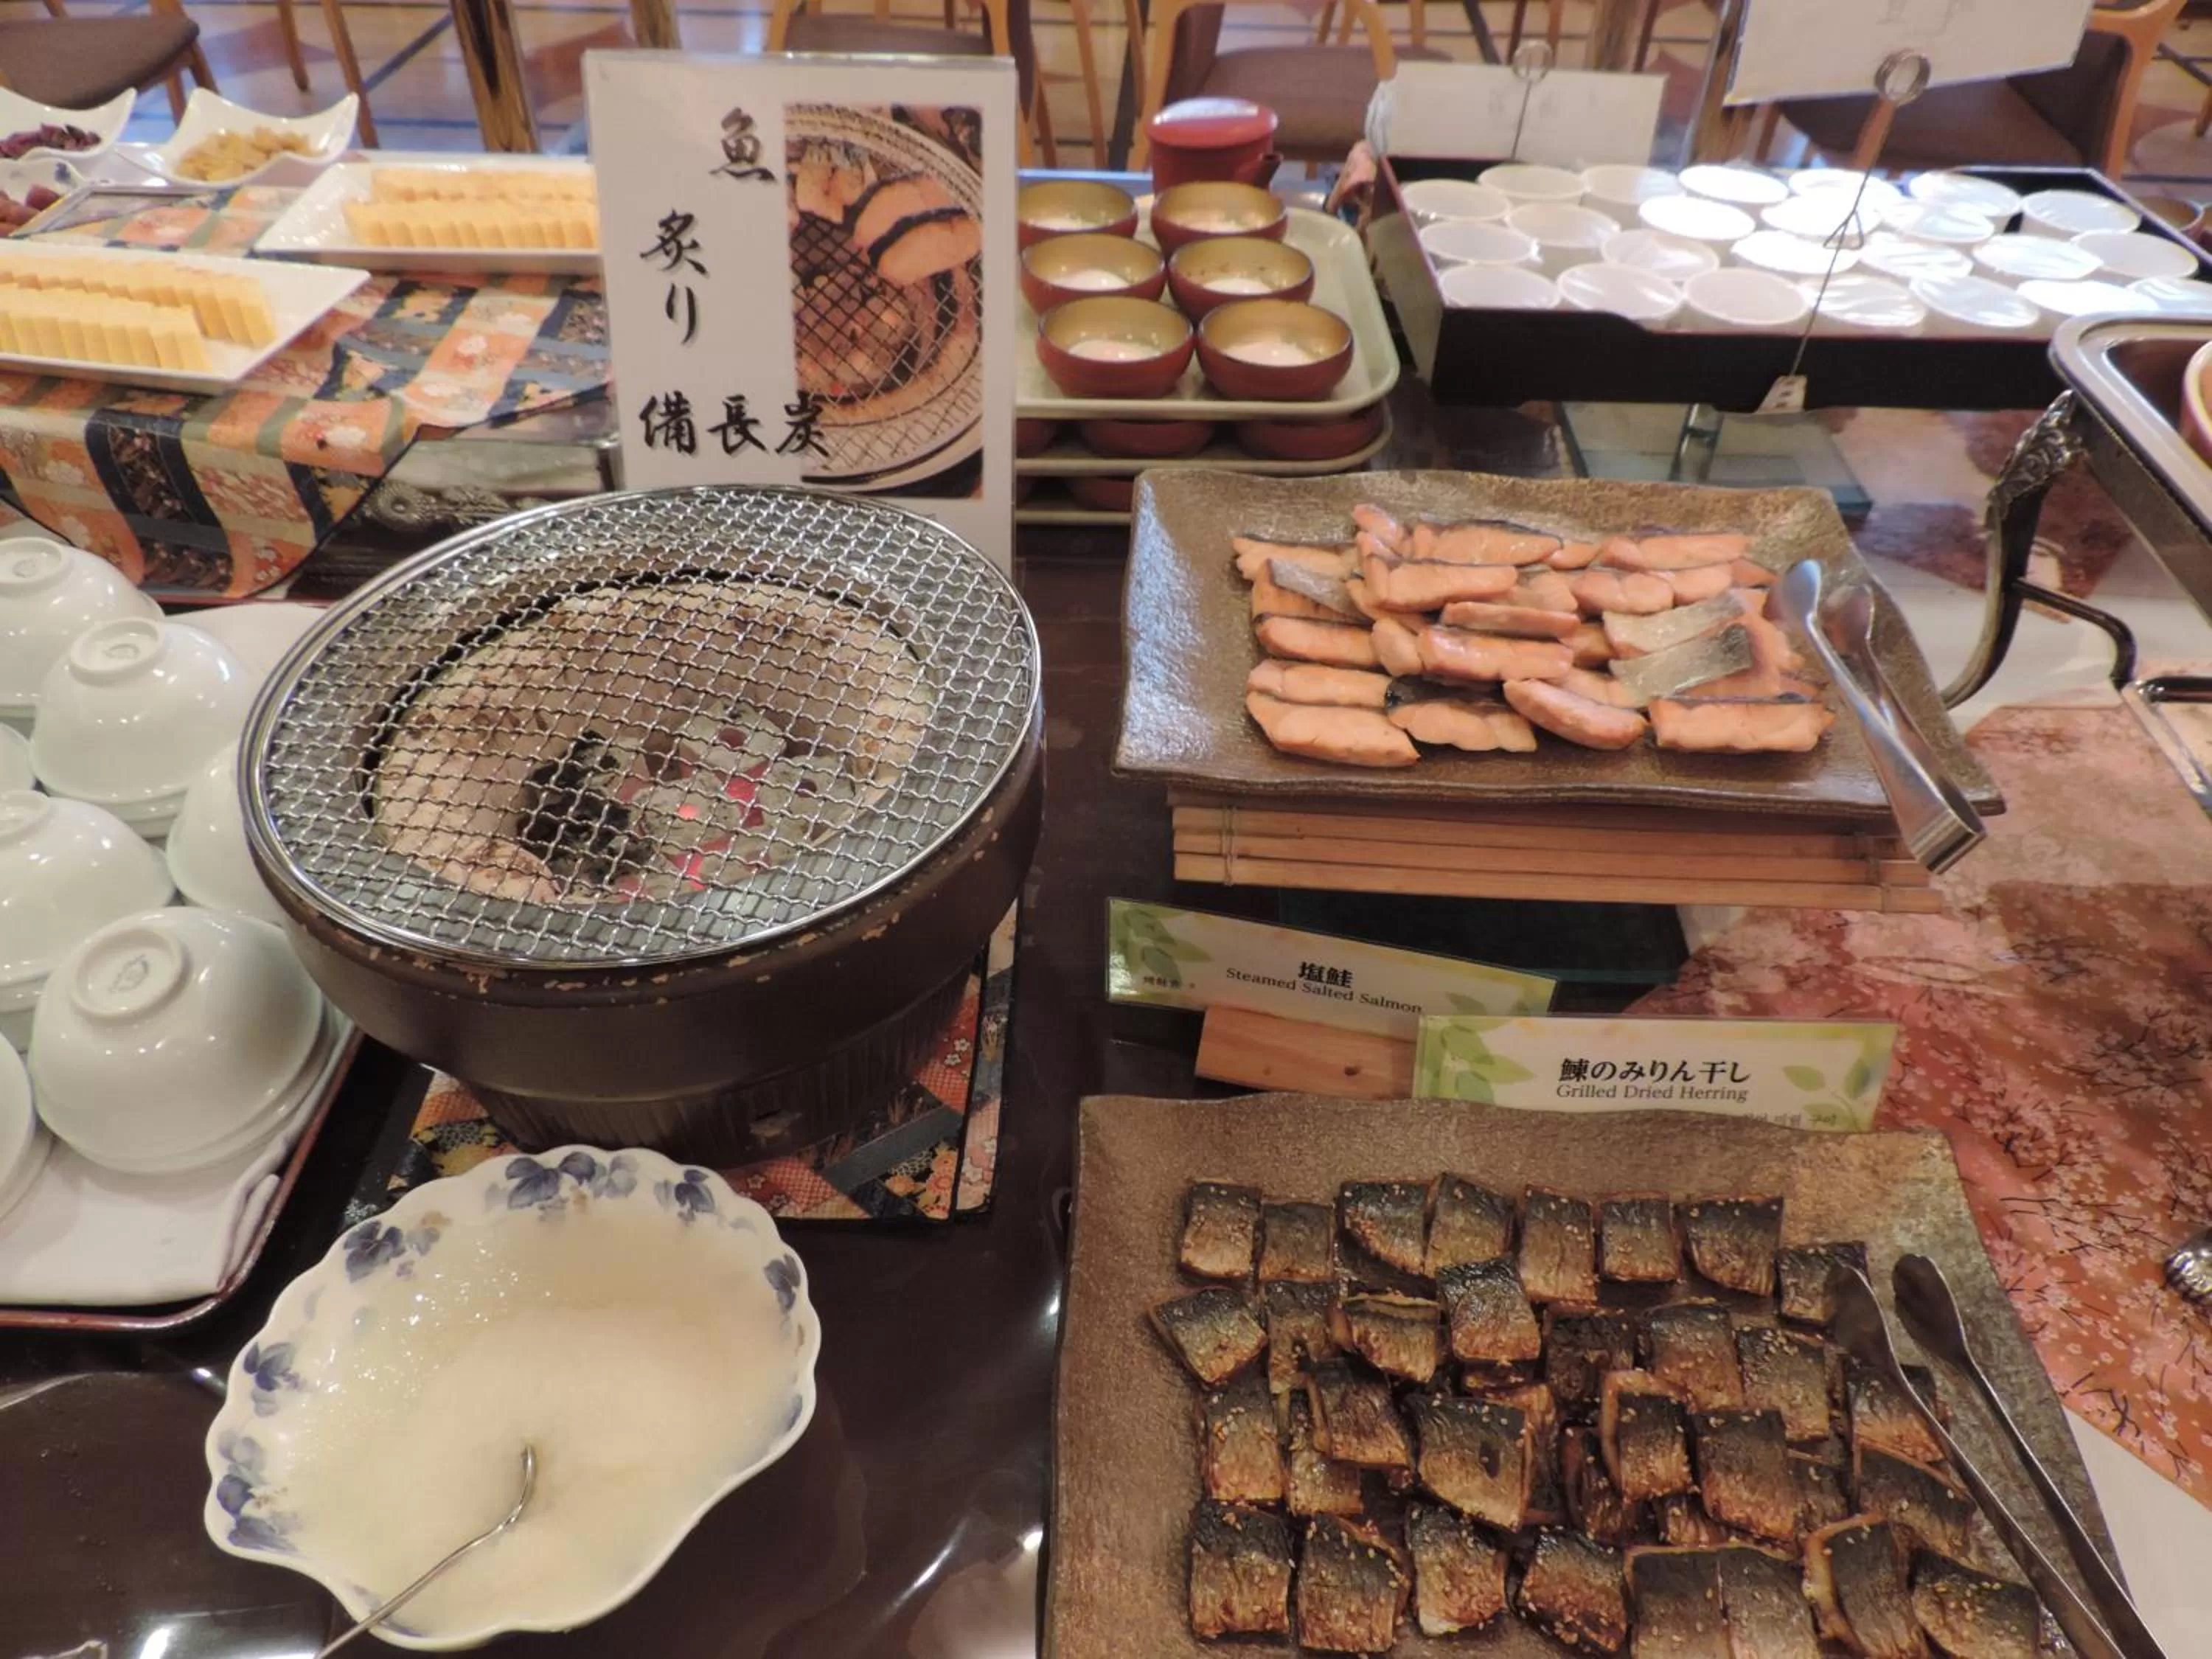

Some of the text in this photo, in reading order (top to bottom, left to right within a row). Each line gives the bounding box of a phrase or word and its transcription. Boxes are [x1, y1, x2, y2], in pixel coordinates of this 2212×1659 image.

[709, 106, 776, 182] 魚
[639, 209, 710, 346] 炙り
[638, 391, 830, 457] 備長炭
[1225, 967, 1422, 1015] Steamed Salted Salmon
[1298, 960, 1353, 989] 塩鮭
[1556, 1084, 1750, 1103] Grilled Dried Herring
[1558, 1057, 1751, 1085] 鰊のみりん干し
